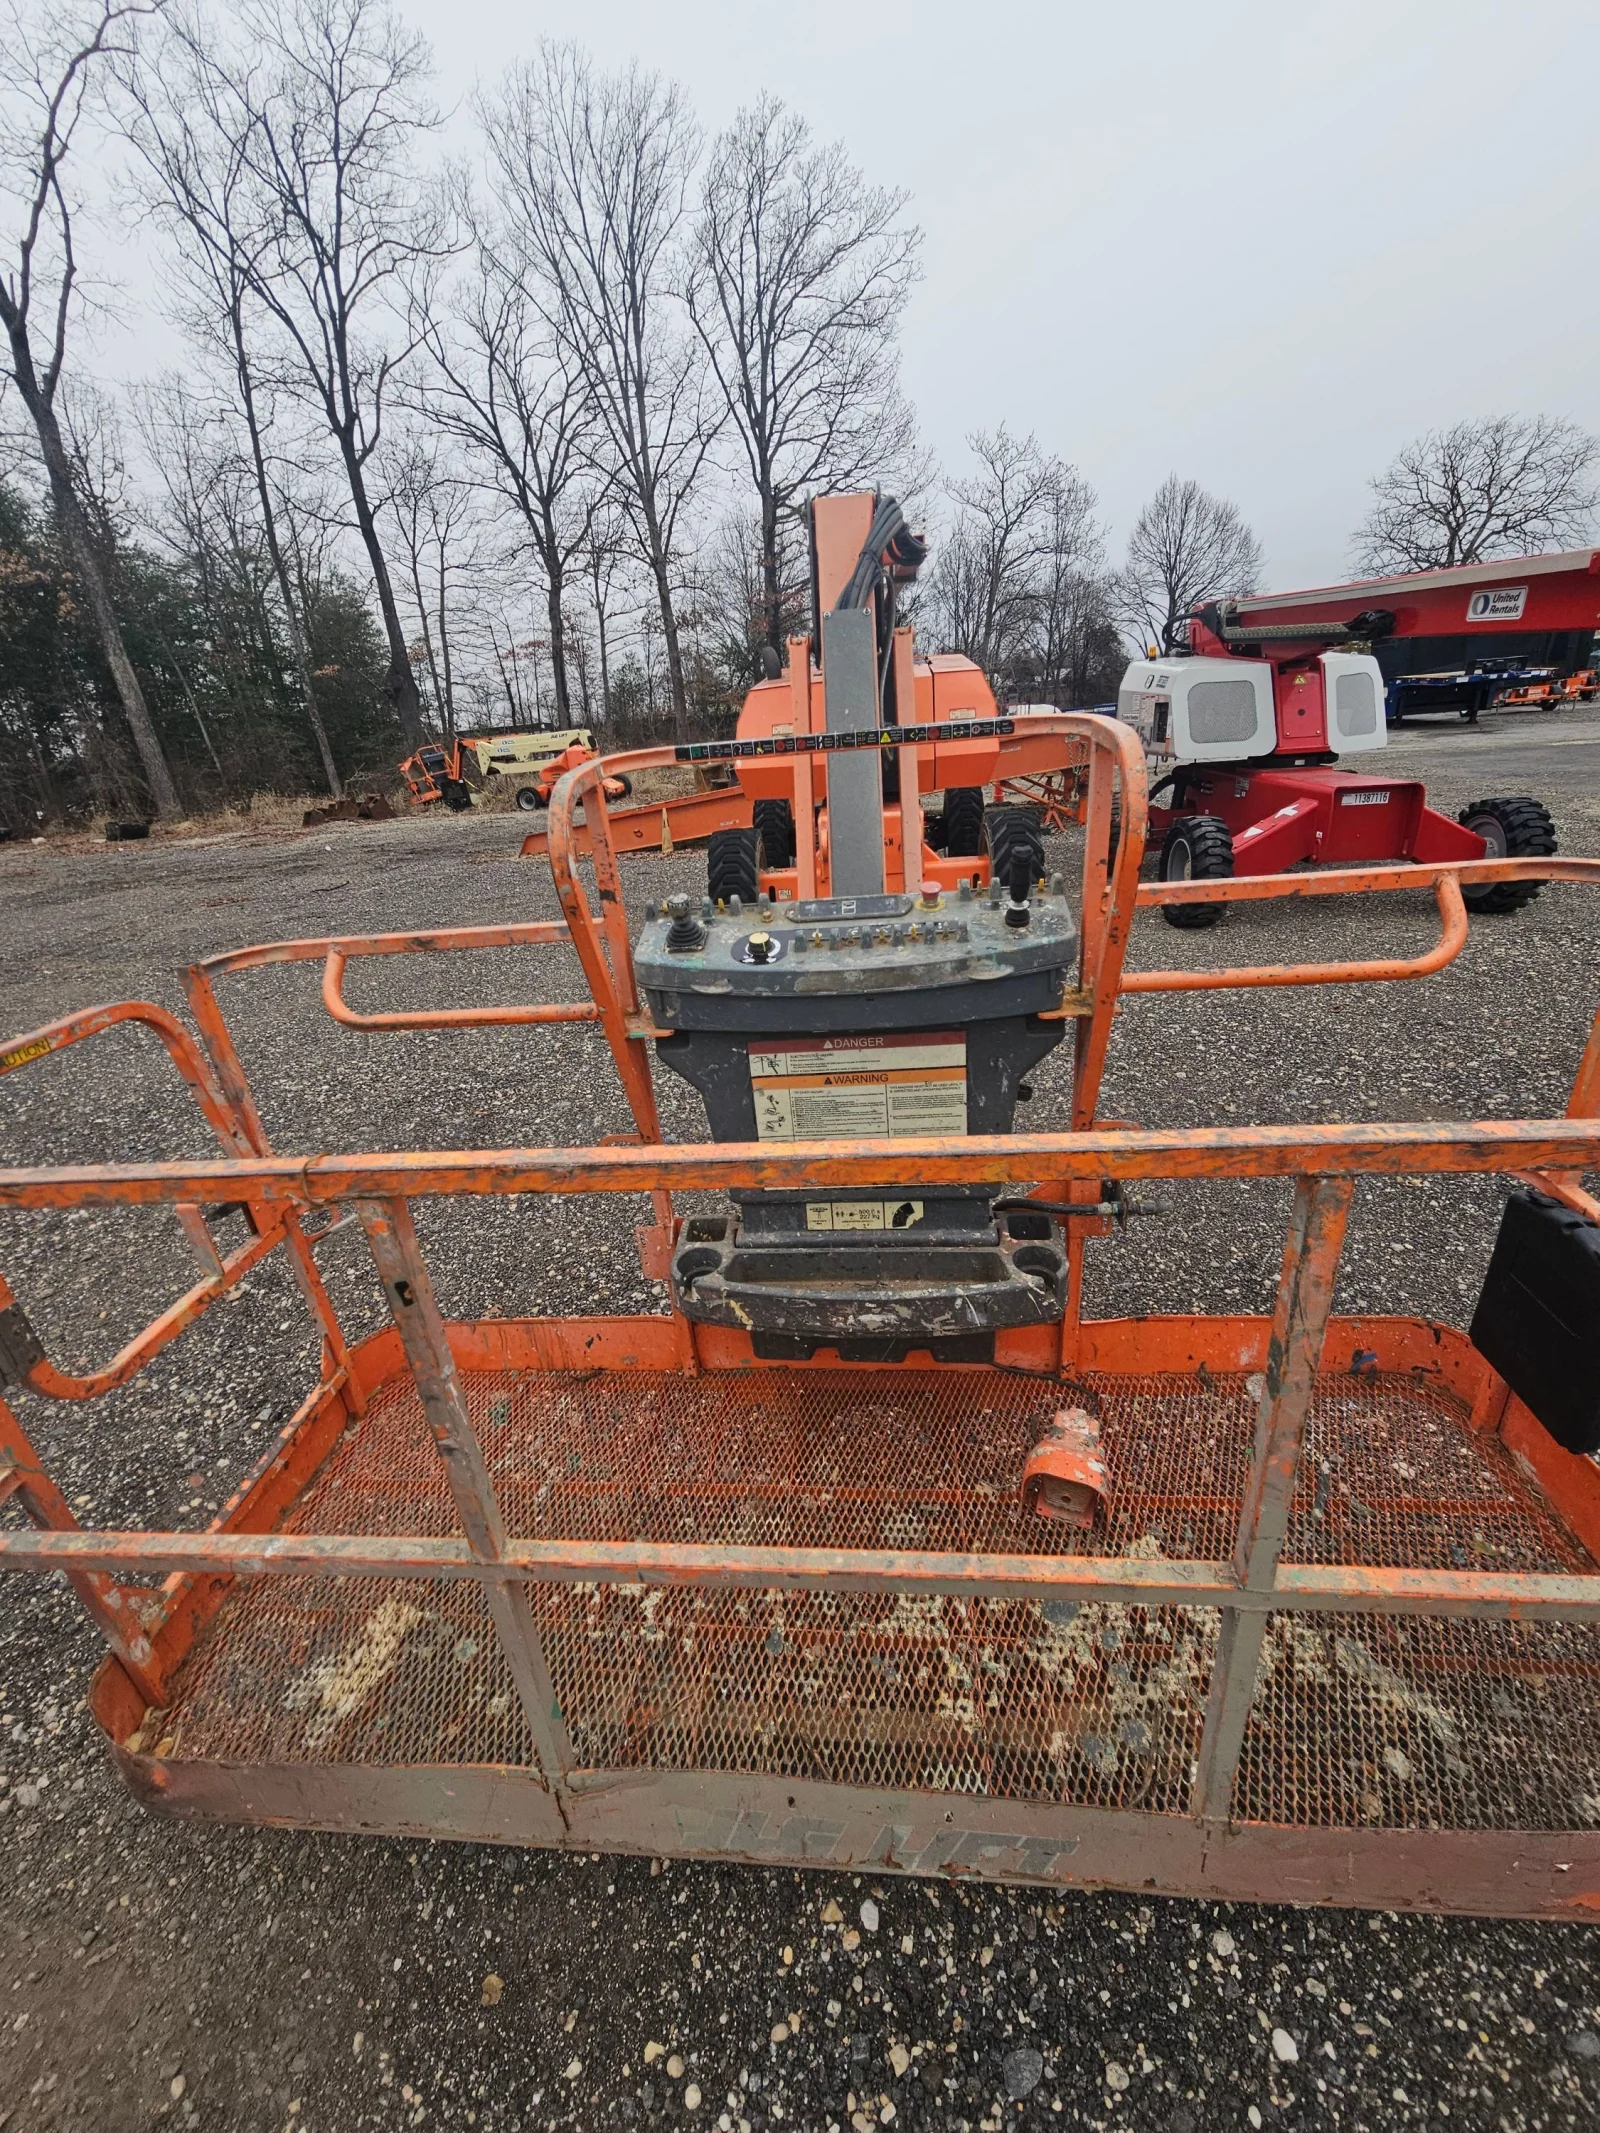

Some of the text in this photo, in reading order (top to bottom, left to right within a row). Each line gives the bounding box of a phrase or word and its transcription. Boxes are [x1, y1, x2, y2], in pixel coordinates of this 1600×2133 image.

[1492, 591, 1522, 604] United
[1489, 604, 1520, 615] Rentals
[1354, 792, 1388, 804] 11387116
[834, 1037, 884, 1049] DANGER
[833, 1073, 889, 1085] WARNING
